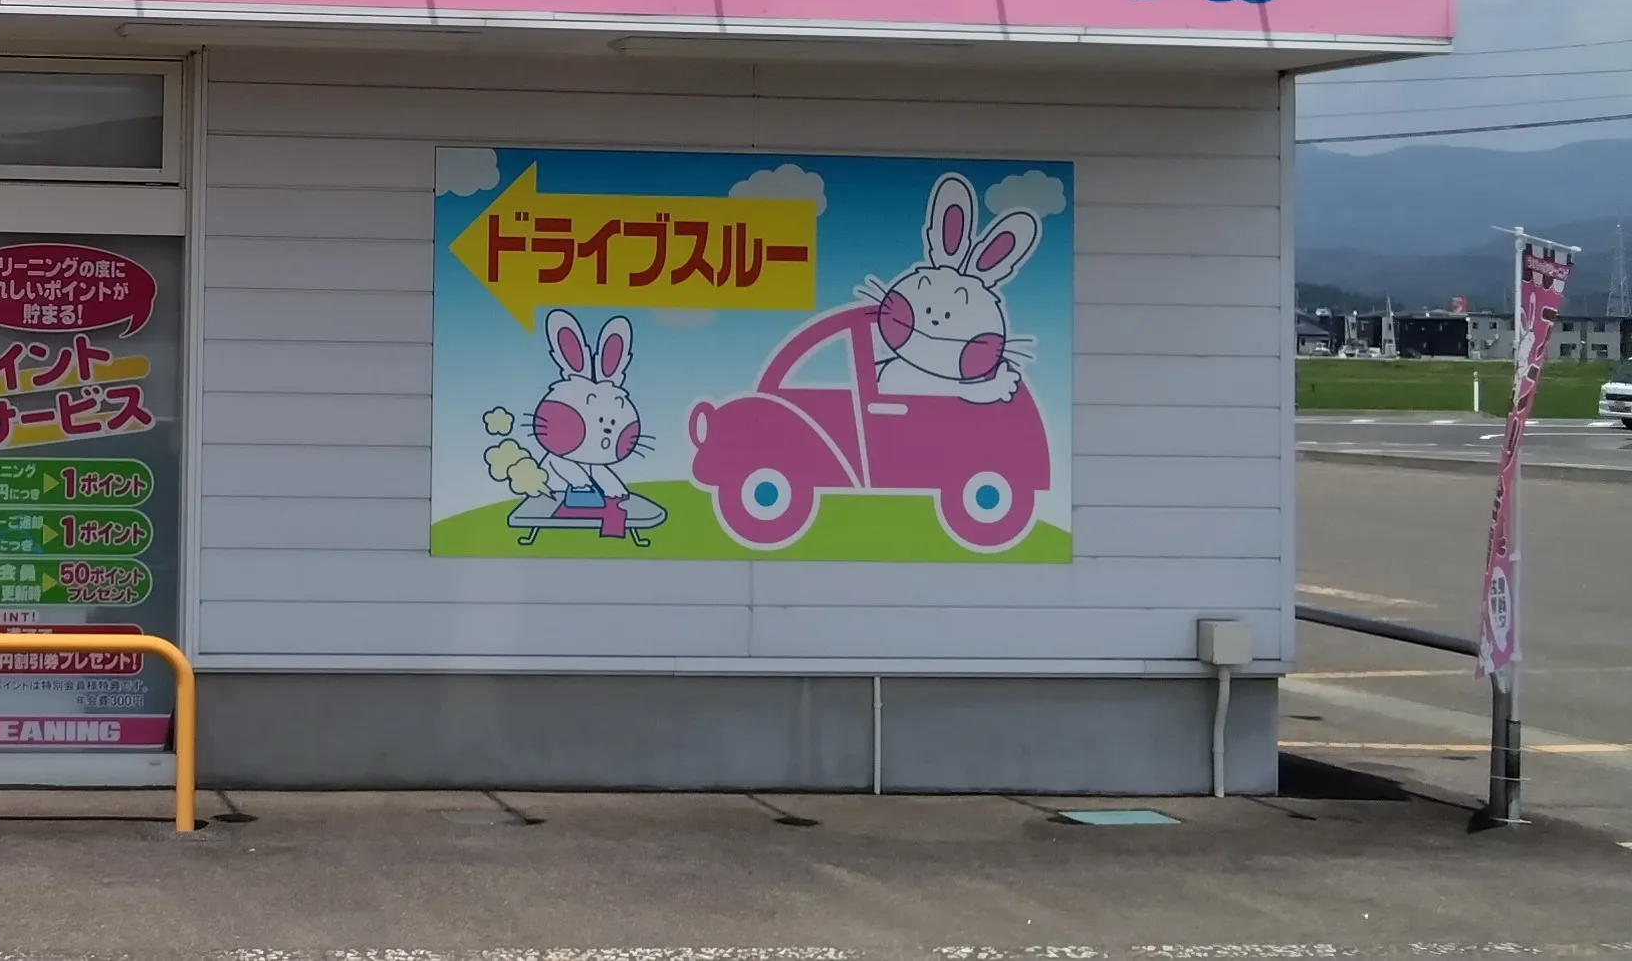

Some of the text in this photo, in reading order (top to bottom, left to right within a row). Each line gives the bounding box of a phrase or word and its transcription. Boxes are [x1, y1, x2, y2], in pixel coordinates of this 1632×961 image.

[486, 210, 809, 288] ドライブスルー
[23, 303, 84, 326] 貯まる!
[60, 466, 148, 500] 1ポイント
[59, 514, 148, 549] 1ポイント
[59, 561, 145, 586] 50ポイント
[67, 587, 139, 604] プレゼント
[74, 694, 146, 708] 年会費300円
